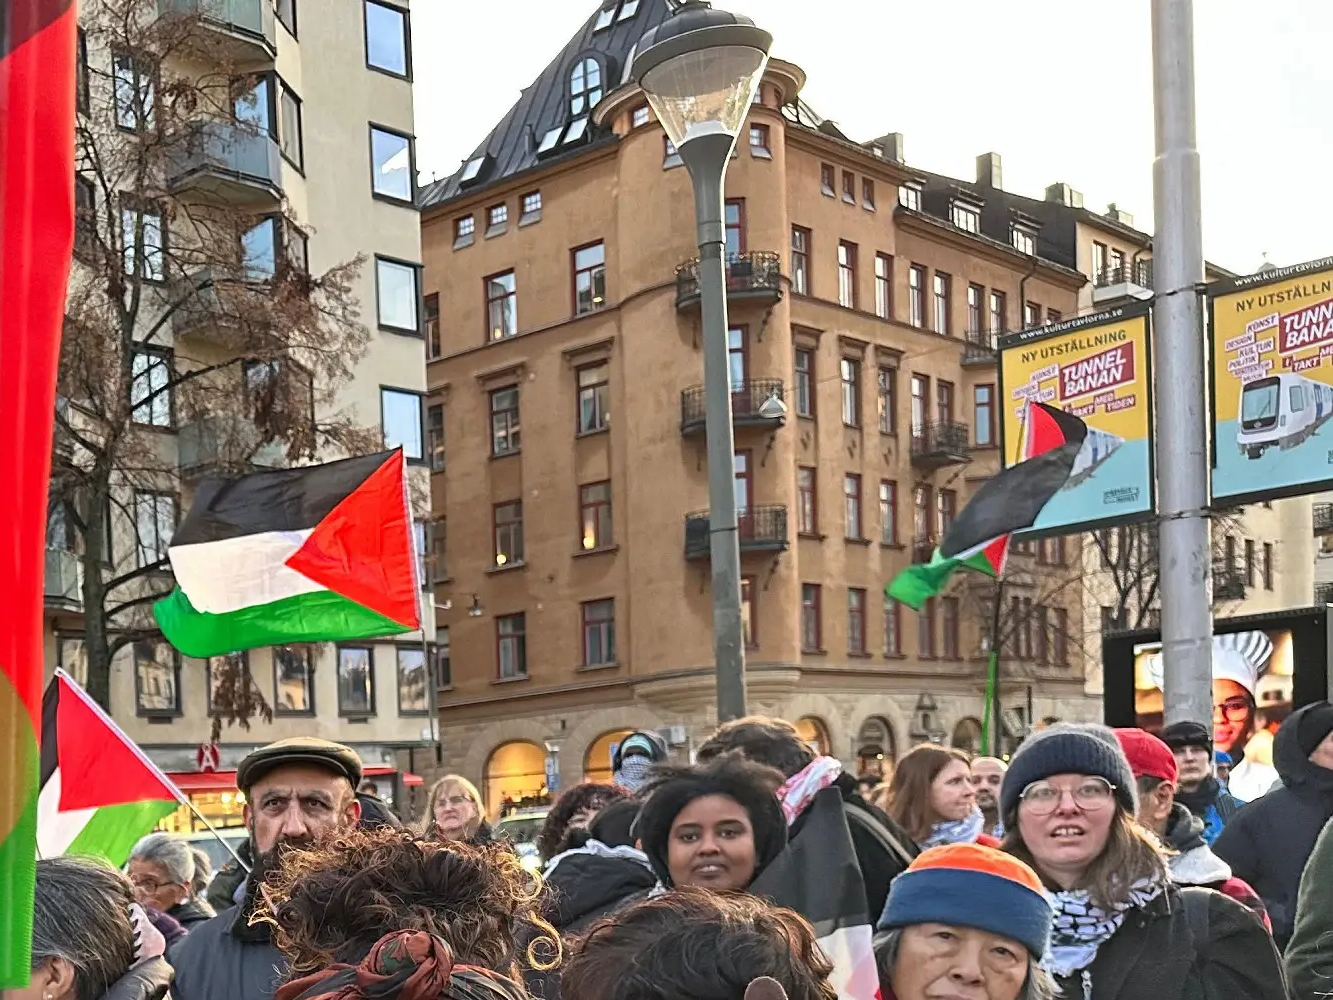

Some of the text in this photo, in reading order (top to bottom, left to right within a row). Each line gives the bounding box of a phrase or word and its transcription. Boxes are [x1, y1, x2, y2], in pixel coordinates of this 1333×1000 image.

[1234, 257, 1333, 286] www.kulturtavlorn
[1236, 280, 1332, 312] NY UTSTÄLLN
[1247, 315, 1277, 332] KONST
[1284, 302, 1333, 333] TUNN
[1021, 329, 1127, 363] NY UTSTÄLLNING
[1286, 319, 1333, 348] BANA
[1240, 340, 1272, 357] KULTUR
[1062, 348, 1127, 383] TUNNEL
[1293, 357, 1319, 371] TAKT
[1064, 366, 1123, 397] BANAN
[1107, 396, 1134, 411] TIDEN
[199, 743, 217, 772] Å
